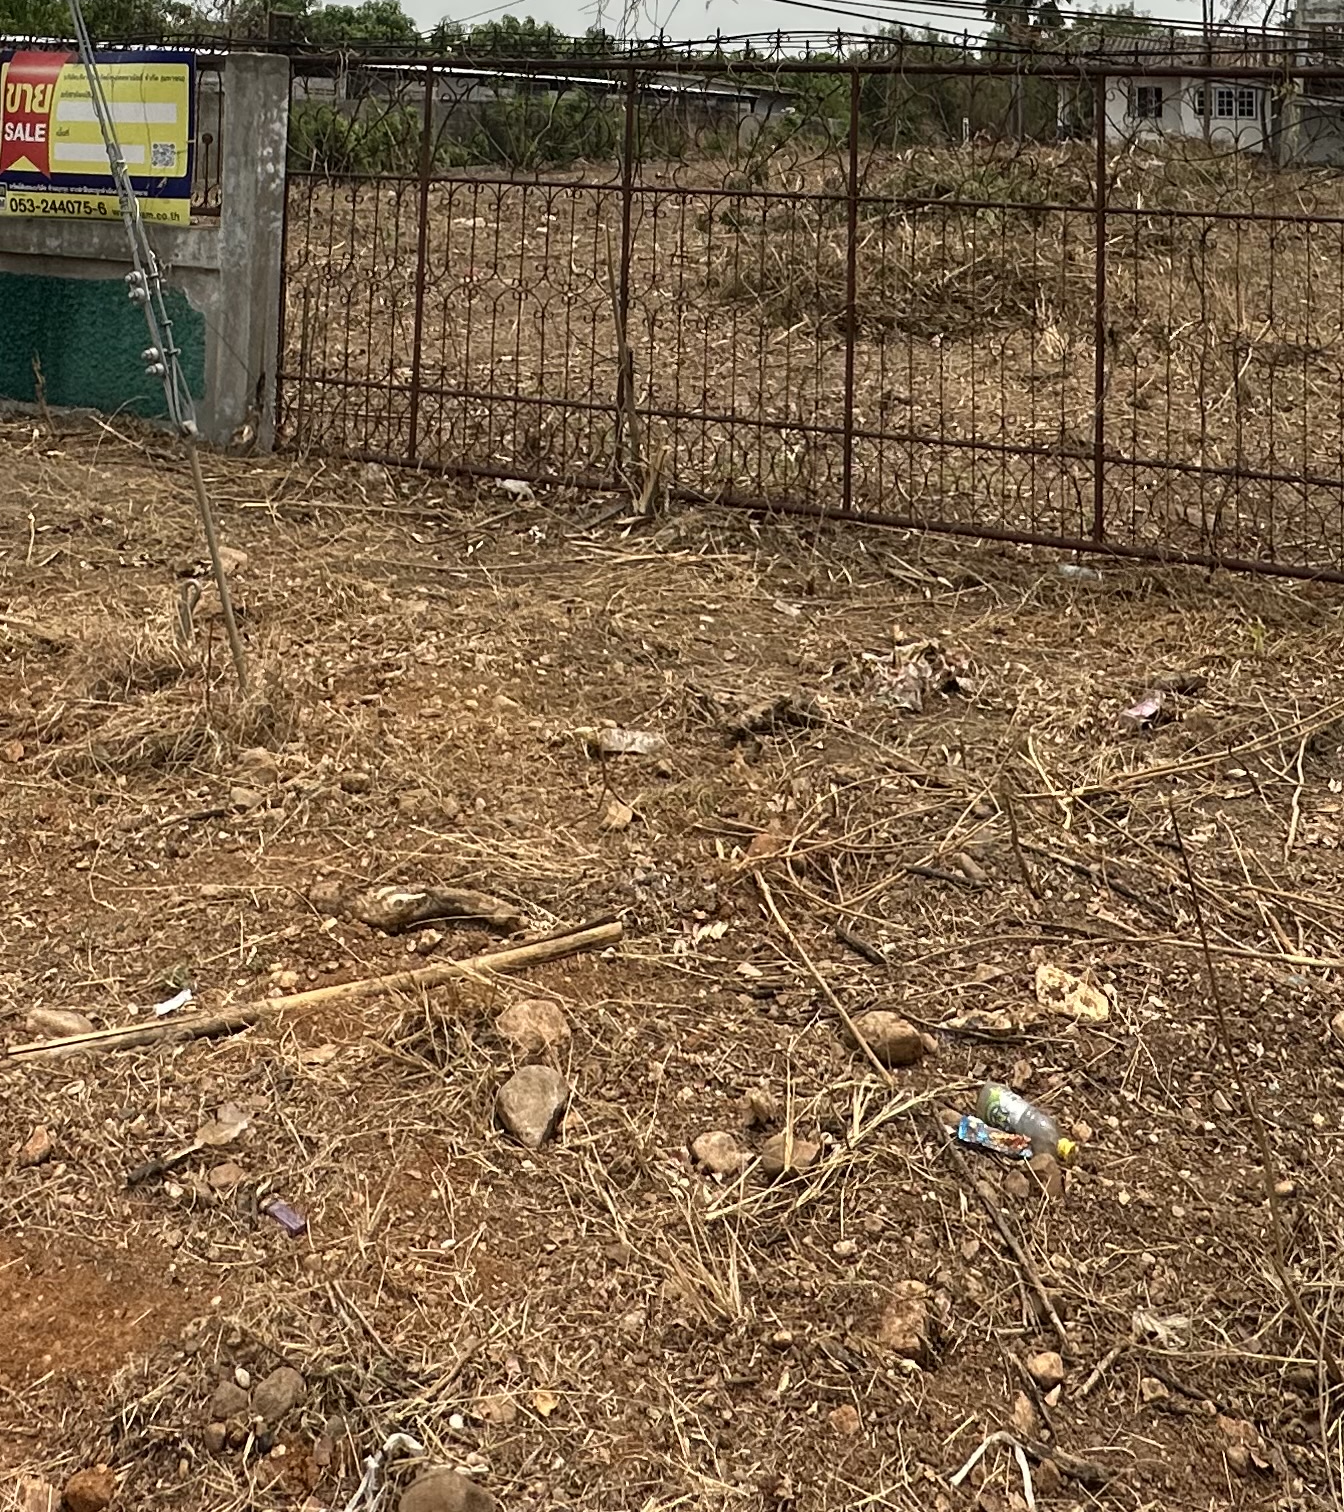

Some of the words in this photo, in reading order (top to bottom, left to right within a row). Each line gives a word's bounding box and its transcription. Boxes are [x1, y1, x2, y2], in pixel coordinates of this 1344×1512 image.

[6, 82, 53, 114] ขาย
[4, 122, 46, 143] SALE
[9, 197, 107, 216] 053-244075-6
